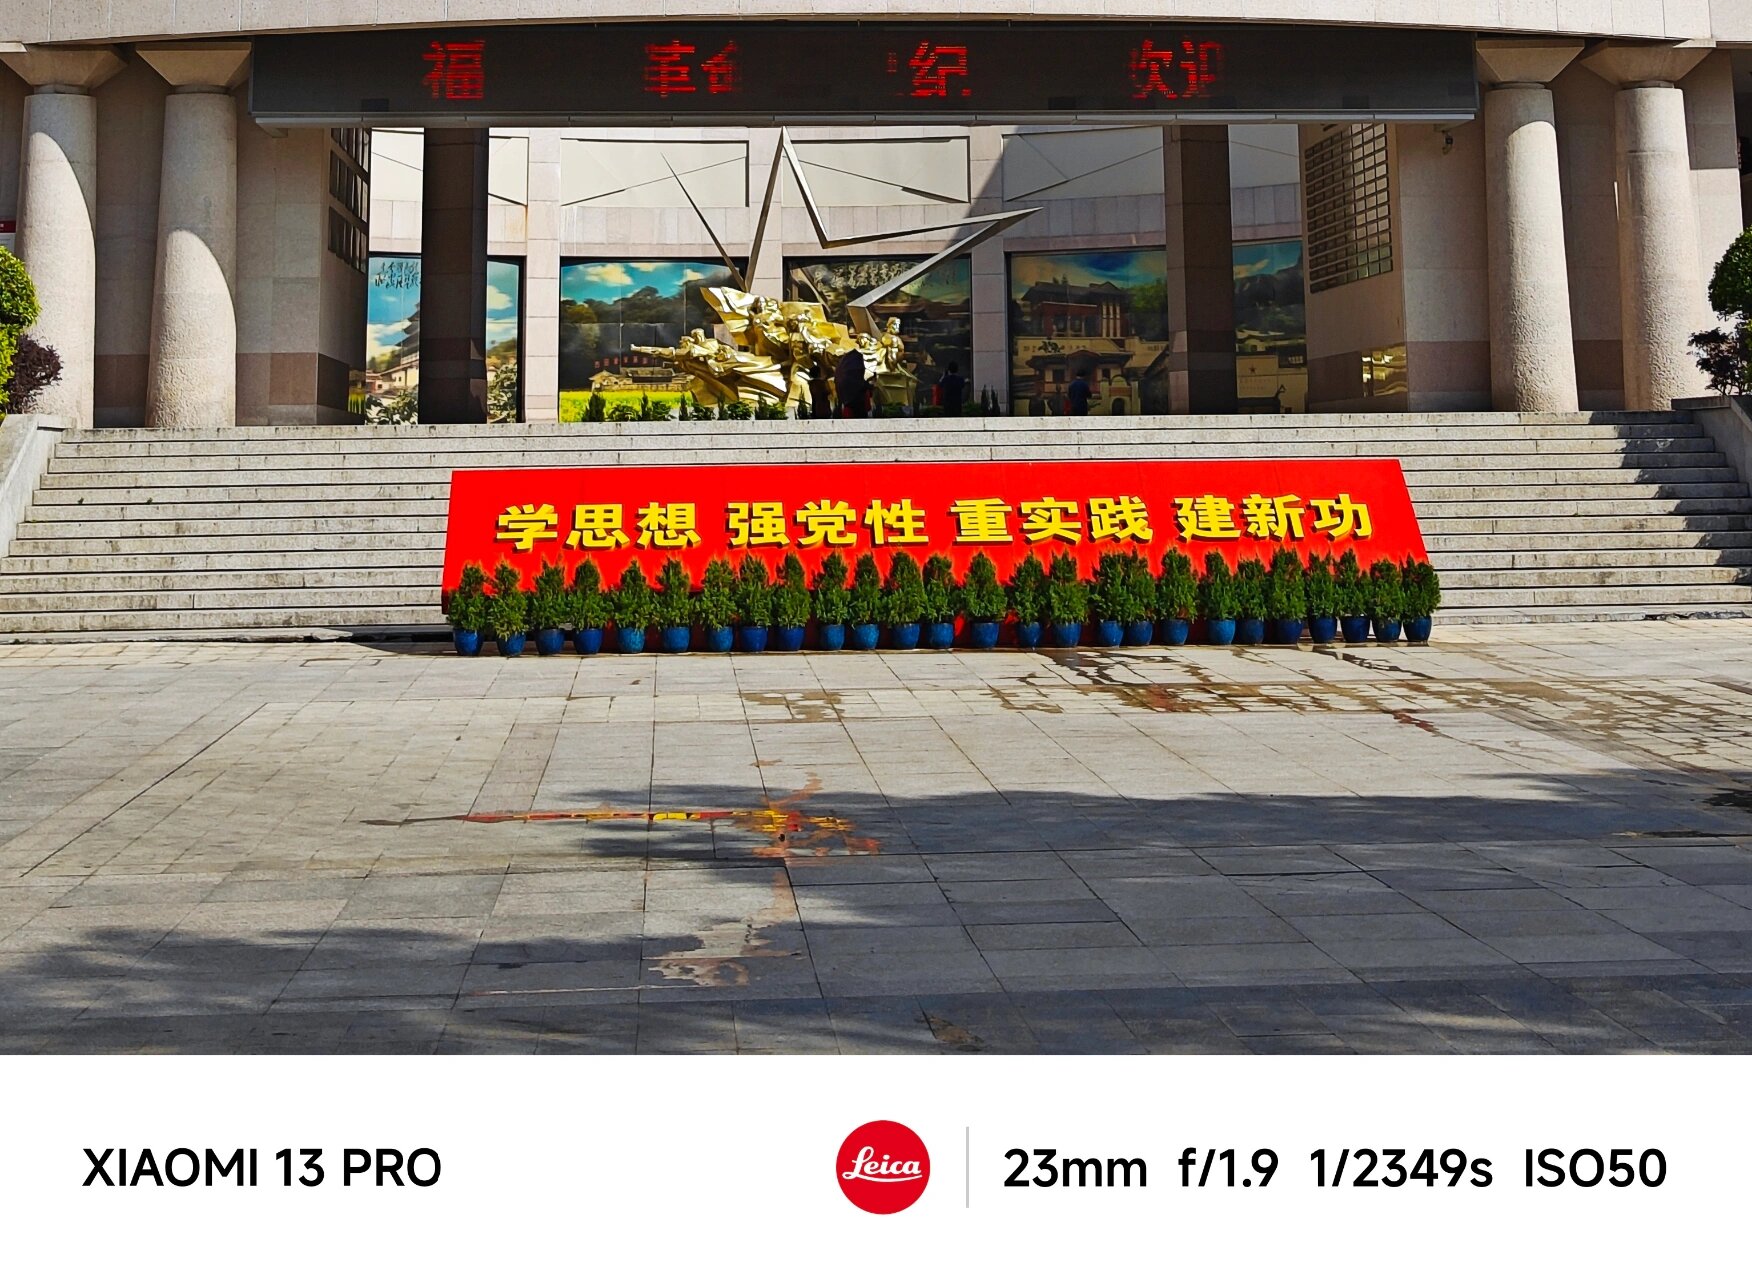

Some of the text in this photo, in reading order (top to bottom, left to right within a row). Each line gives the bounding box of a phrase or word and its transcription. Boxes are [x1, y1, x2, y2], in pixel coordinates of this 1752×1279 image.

[422, 40, 486, 100] 福
[495, 494, 1374, 550] 学思想 强党性 重实践 建新功
